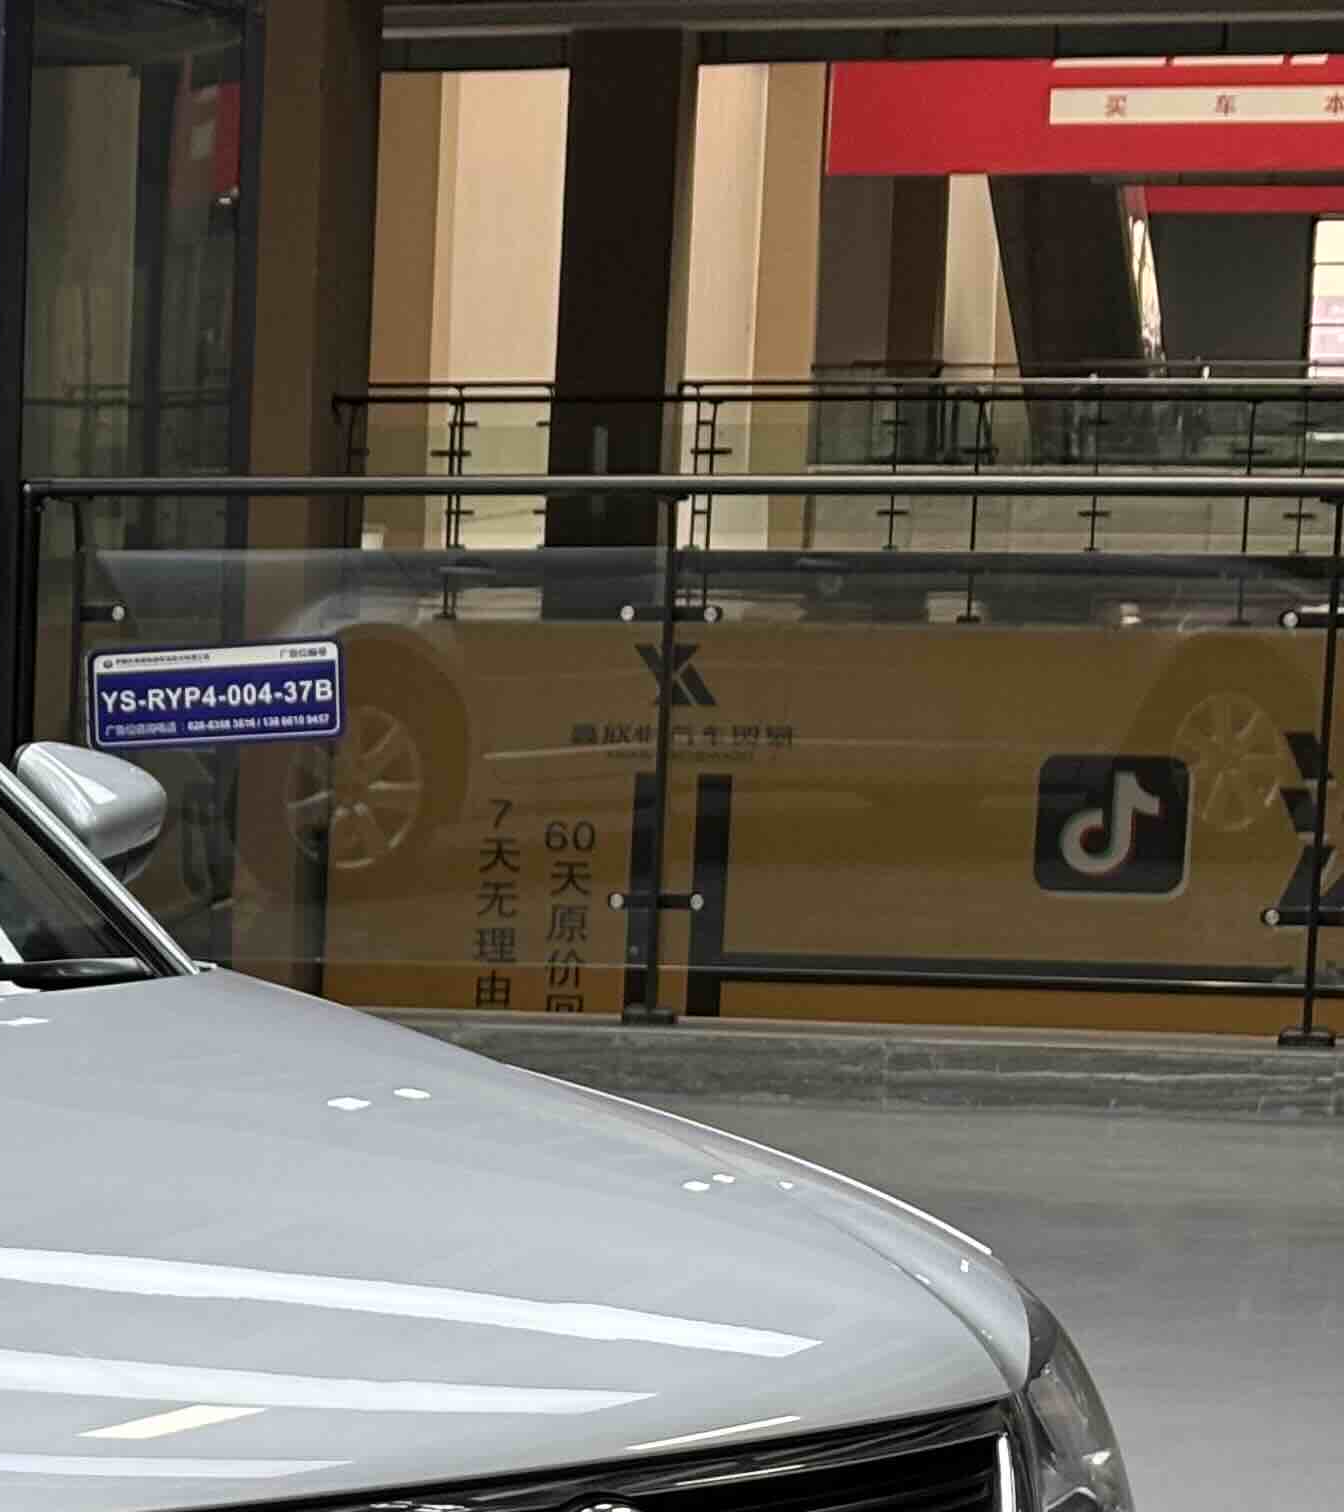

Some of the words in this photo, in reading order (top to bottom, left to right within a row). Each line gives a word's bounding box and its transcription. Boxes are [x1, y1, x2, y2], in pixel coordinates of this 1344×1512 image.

[100, 679, 334, 713] YS-RYP4-004-37B
[474, 799, 521, 1007] 7天无理由
